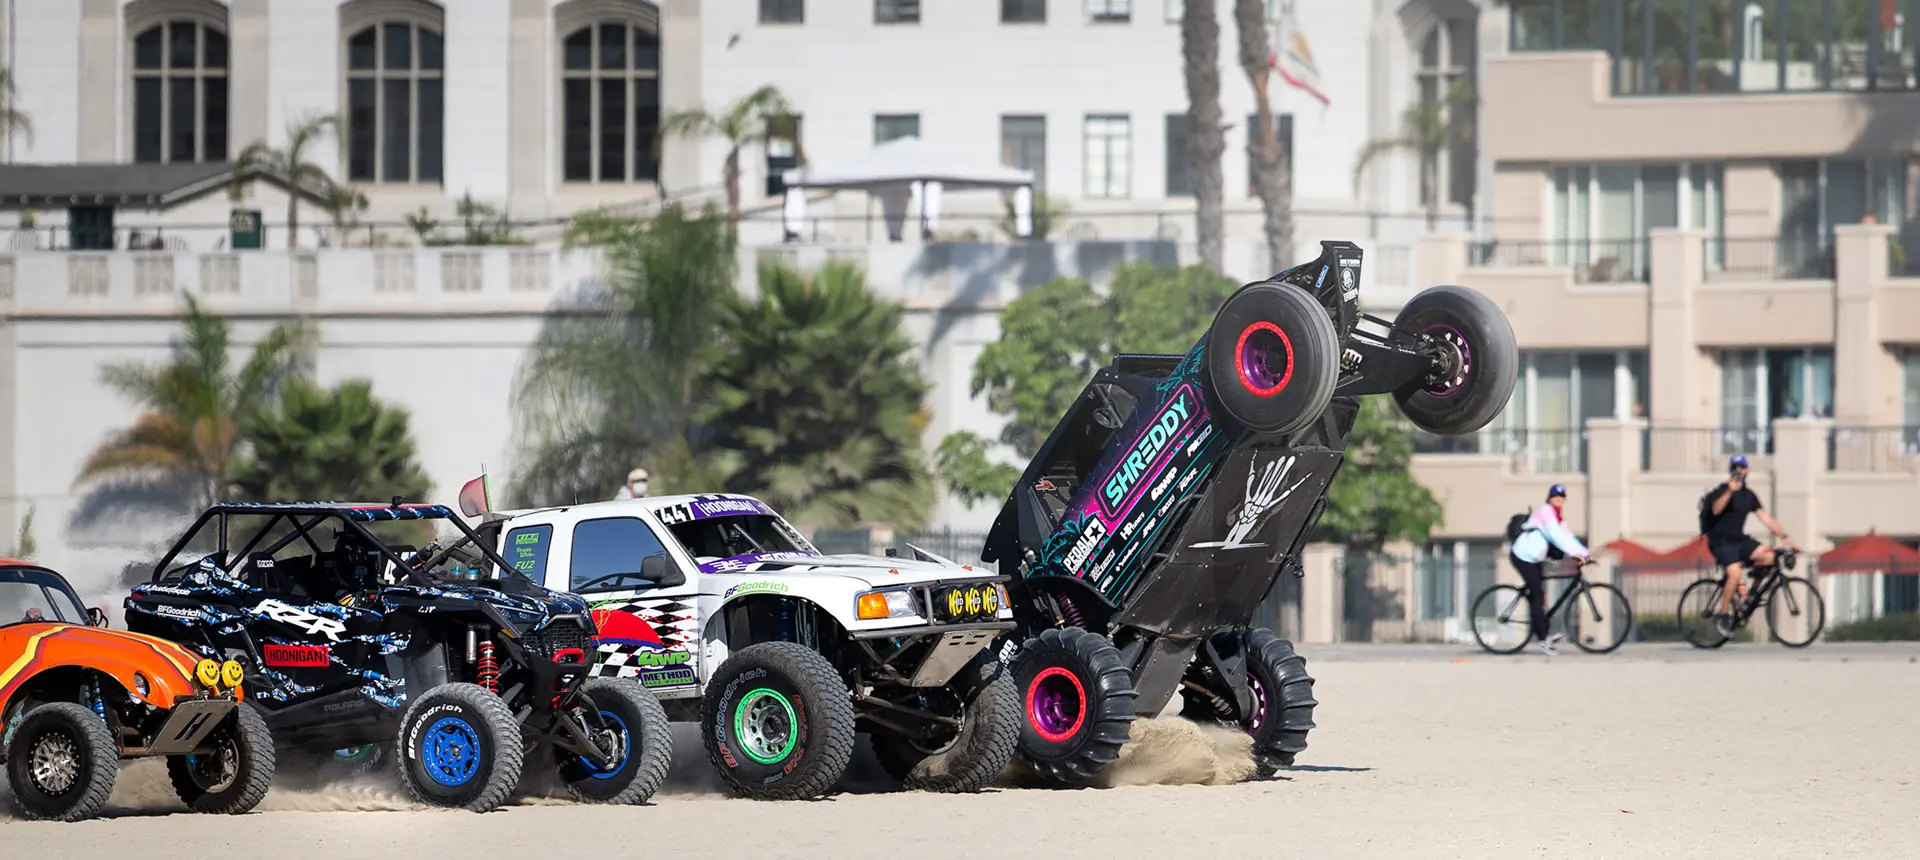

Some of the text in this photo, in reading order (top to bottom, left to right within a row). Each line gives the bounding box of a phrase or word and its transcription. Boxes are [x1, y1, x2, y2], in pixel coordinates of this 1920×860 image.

[1106, 394, 1188, 507] SHREDDY
[1187, 424, 1212, 457] RIGID
[1151, 467, 1177, 501] 4WP
[660, 502, 695, 524] 447
[514, 560, 535, 569] FU2
[1063, 535, 1092, 572] PEDAL
[724, 580, 789, 600] BFGoodrich
[948, 589, 962, 616] KC
[965, 588, 980, 615] KC
[982, 586, 996, 613] KC
[157, 605, 201, 617] BFGoodrich
[250, 600, 346, 642] RZR
[638, 650, 690, 666] 4WP
[643, 670, 691, 680] METHOD
[715, 668, 767, 767] BFGoodrich
[408, 704, 463, 760] BFGoodrich
